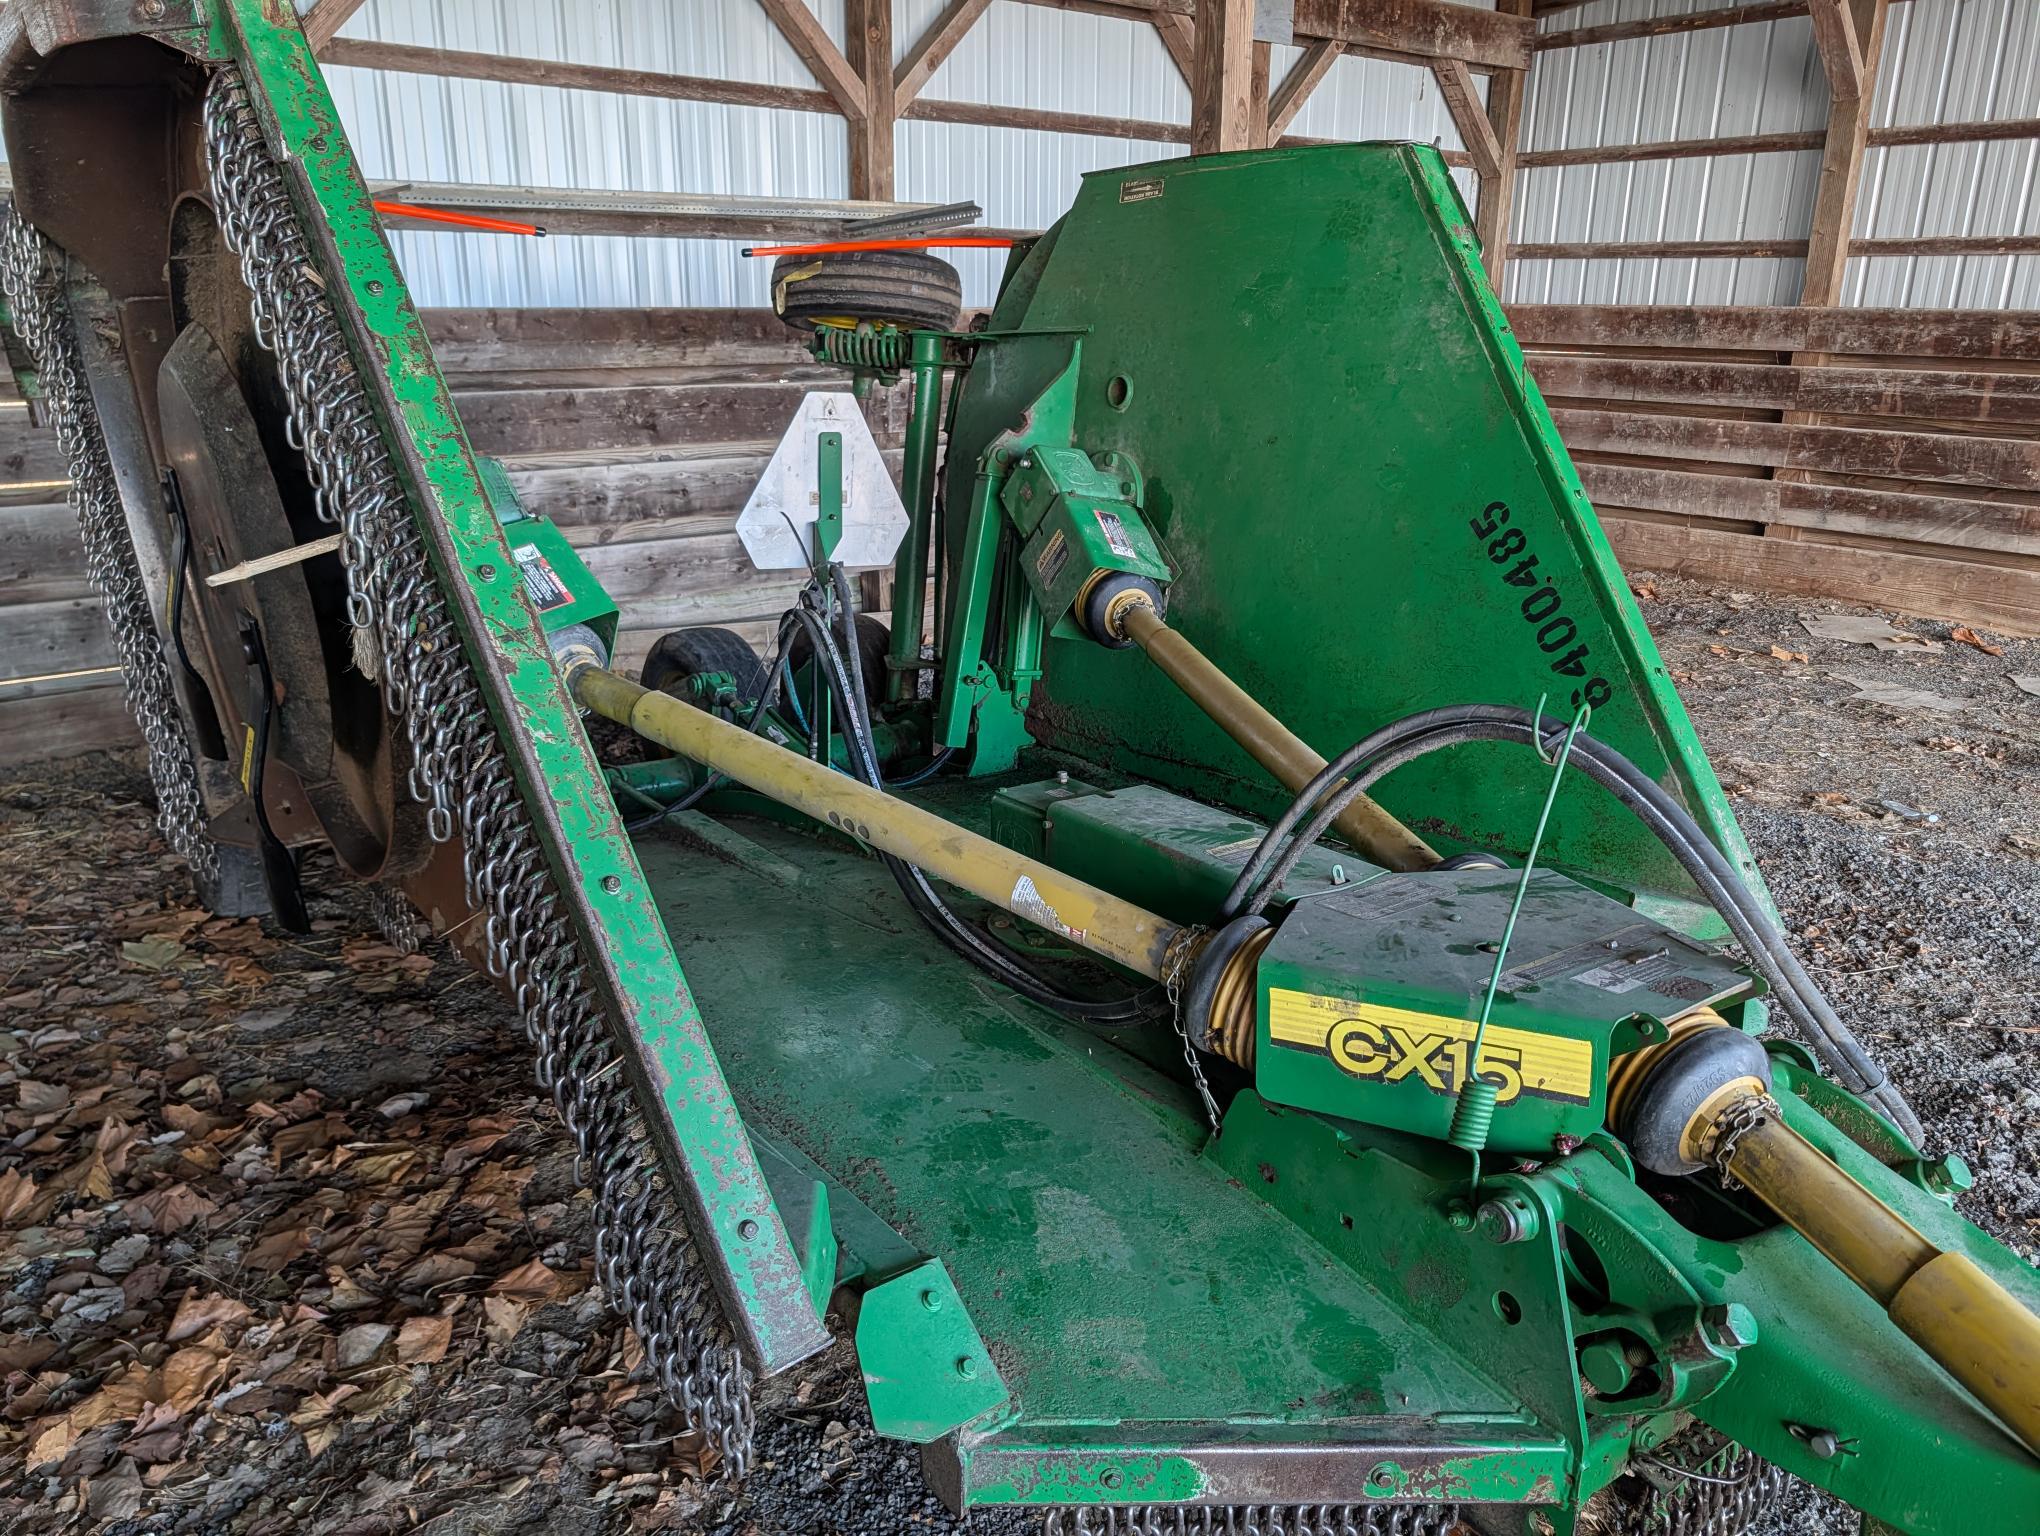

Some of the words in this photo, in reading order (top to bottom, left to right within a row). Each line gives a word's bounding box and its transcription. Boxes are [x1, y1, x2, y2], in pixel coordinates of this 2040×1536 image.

[548, 570, 568, 594] DANGER
[1469, 501, 1612, 711] 6400485
[1325, 1018, 1523, 1107] CX15
